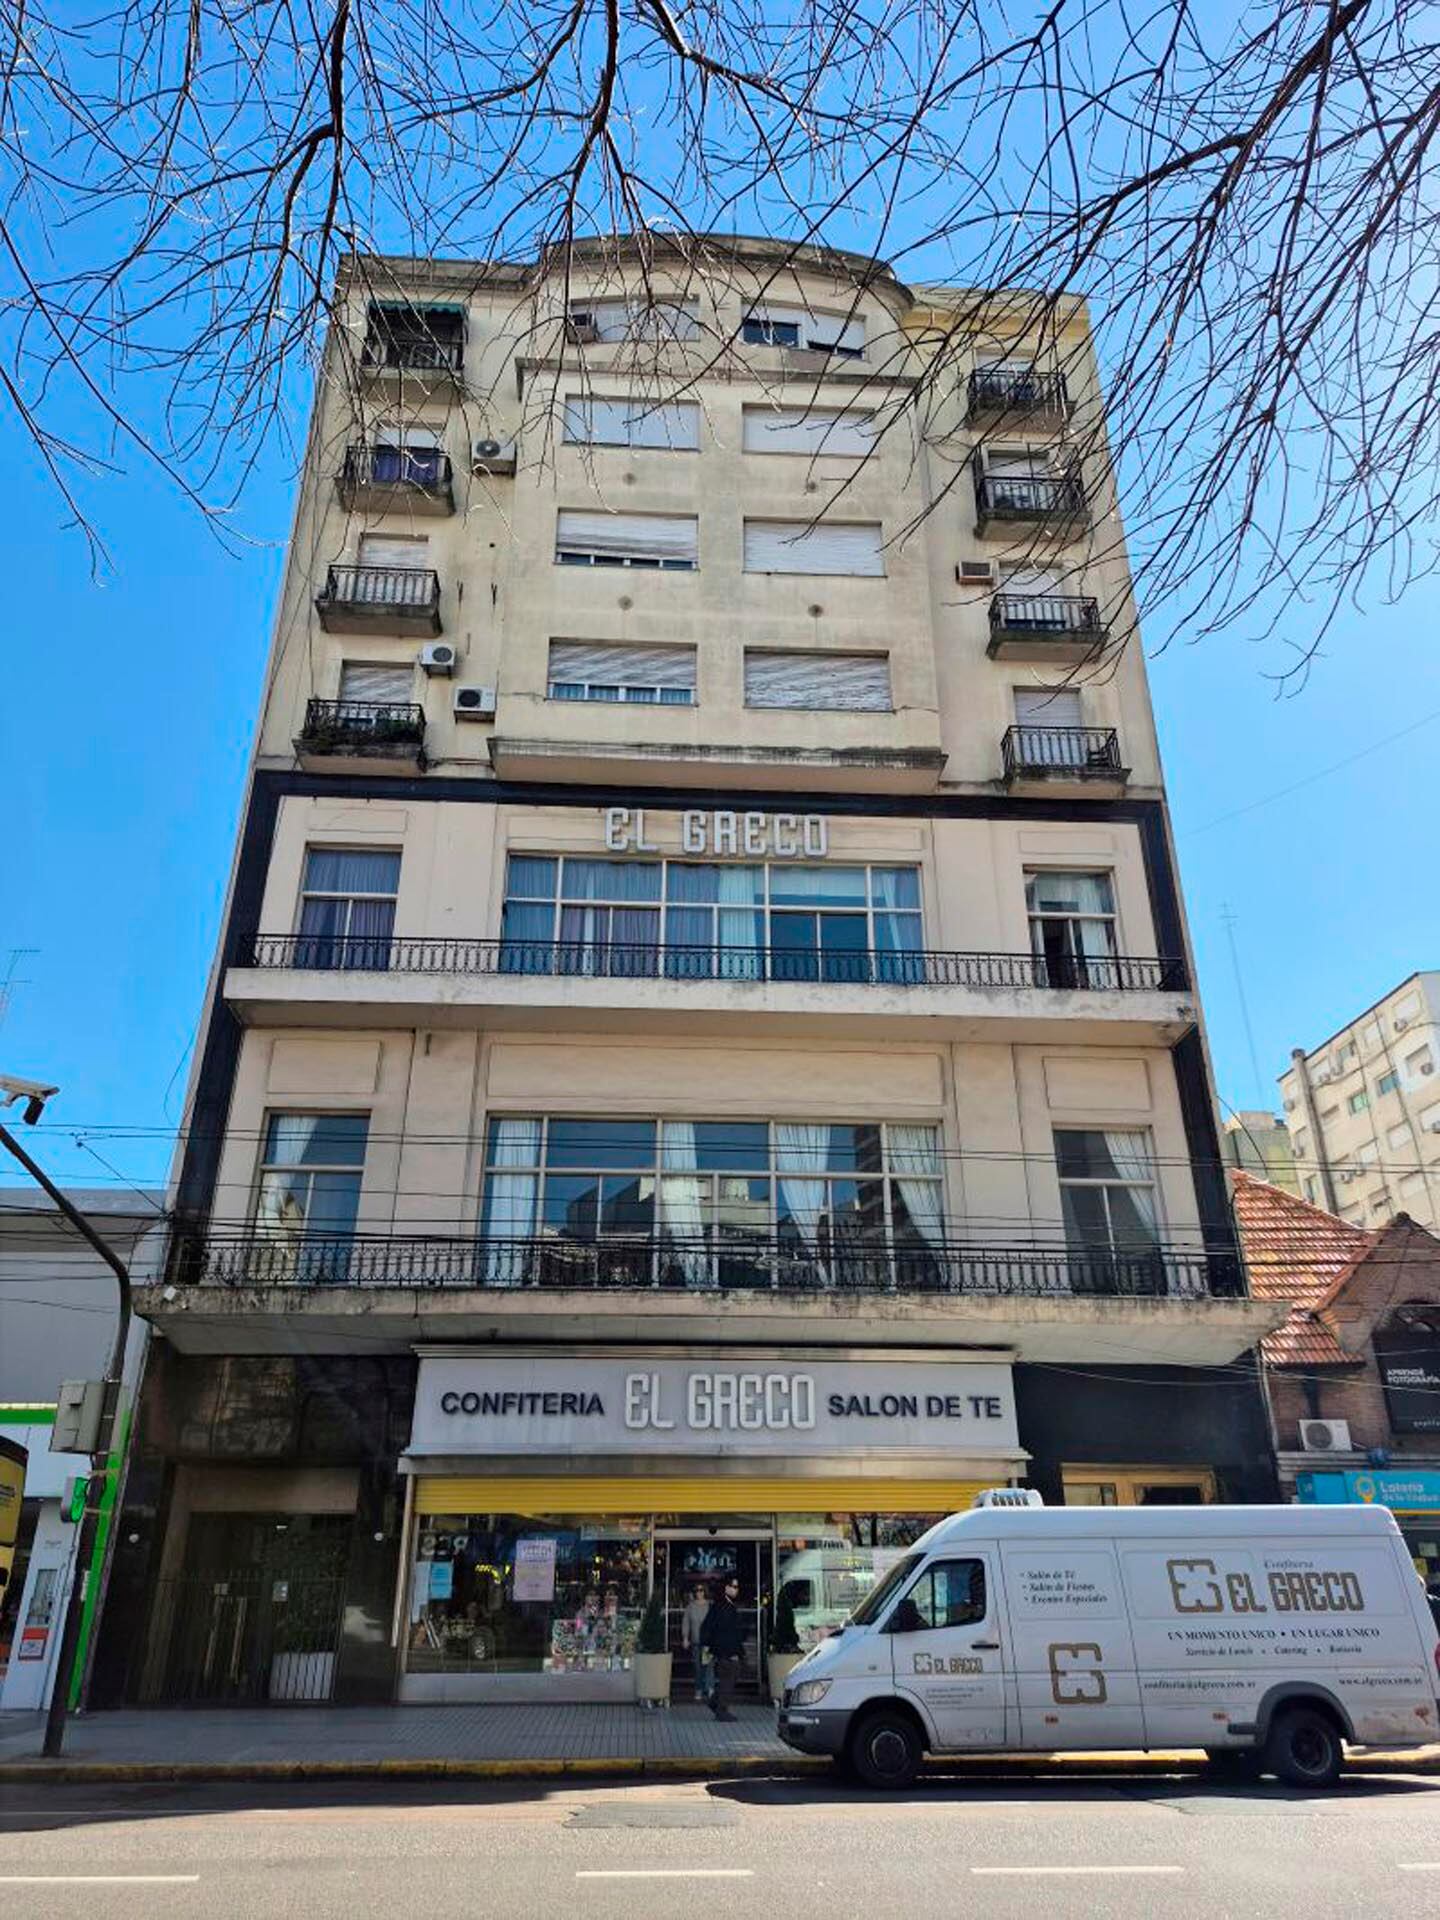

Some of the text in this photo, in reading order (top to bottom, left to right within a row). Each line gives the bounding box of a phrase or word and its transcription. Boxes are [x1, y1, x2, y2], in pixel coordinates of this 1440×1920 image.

[606, 807, 828, 856] EL GRECO
[440, 1373, 1003, 1430] CONFITERIA EL GRECO SALON DE TE
[1225, 1572, 1365, 1613] EL GRECO
[1185, 1630, 1241, 1640] MOMENTO
[1308, 1628, 1343, 1638] LUGAR
